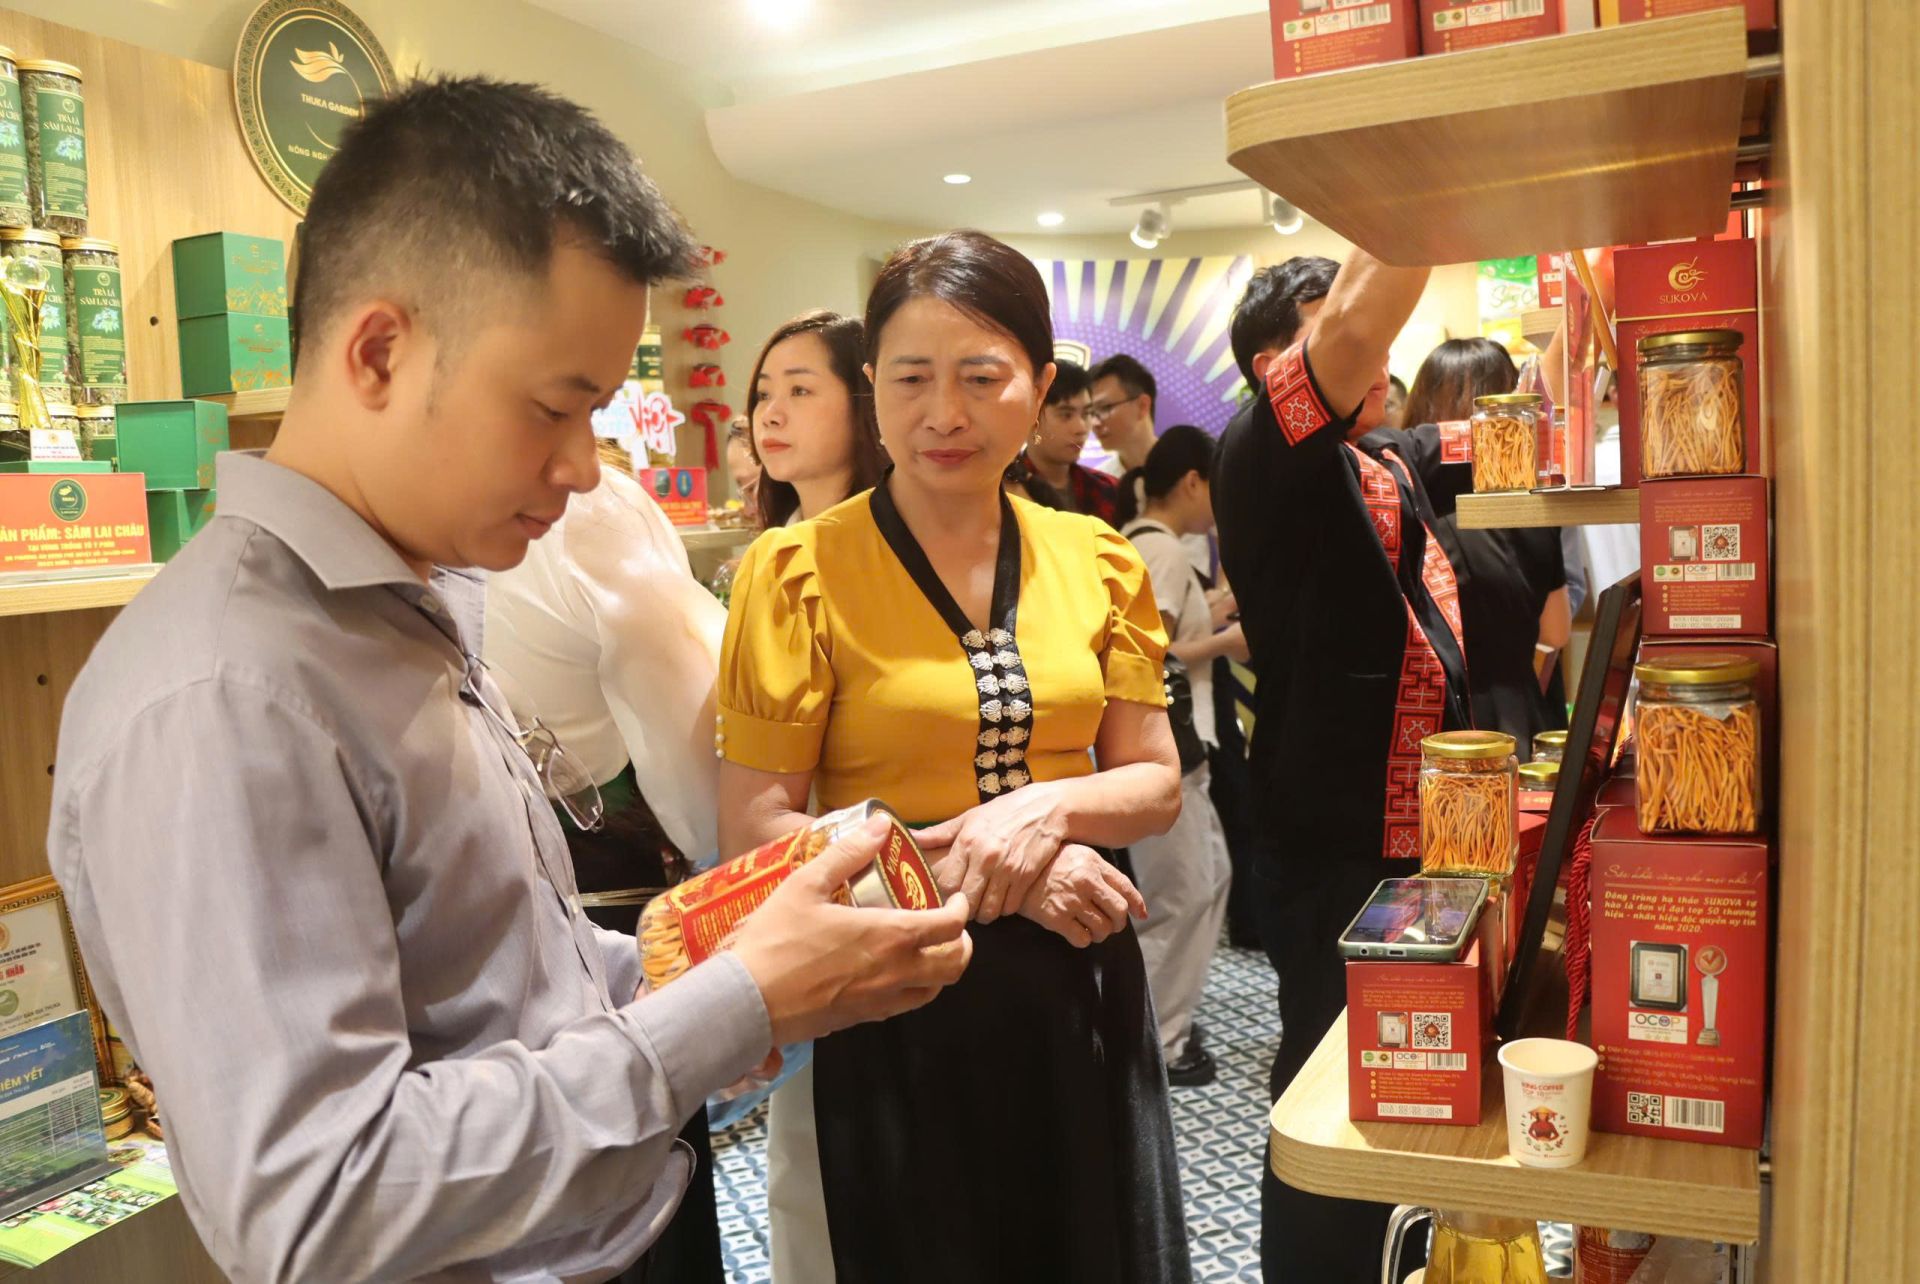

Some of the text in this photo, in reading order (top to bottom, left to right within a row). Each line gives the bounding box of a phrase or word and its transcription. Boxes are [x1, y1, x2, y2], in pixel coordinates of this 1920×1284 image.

[301, 93, 328, 109] THUKA
[1659, 293, 1708, 305] SUKOVA
[64, 525, 91, 540] SÂM
[95, 525, 112, 538] LAI
[1632, 893, 1658, 903] trùng
[1703, 897, 1742, 906] SUKOVA
[1708, 906, 1719, 916] 50
[1635, 1013, 1681, 1027] OCOP
[1538, 1083, 1565, 1091] COFFEE
